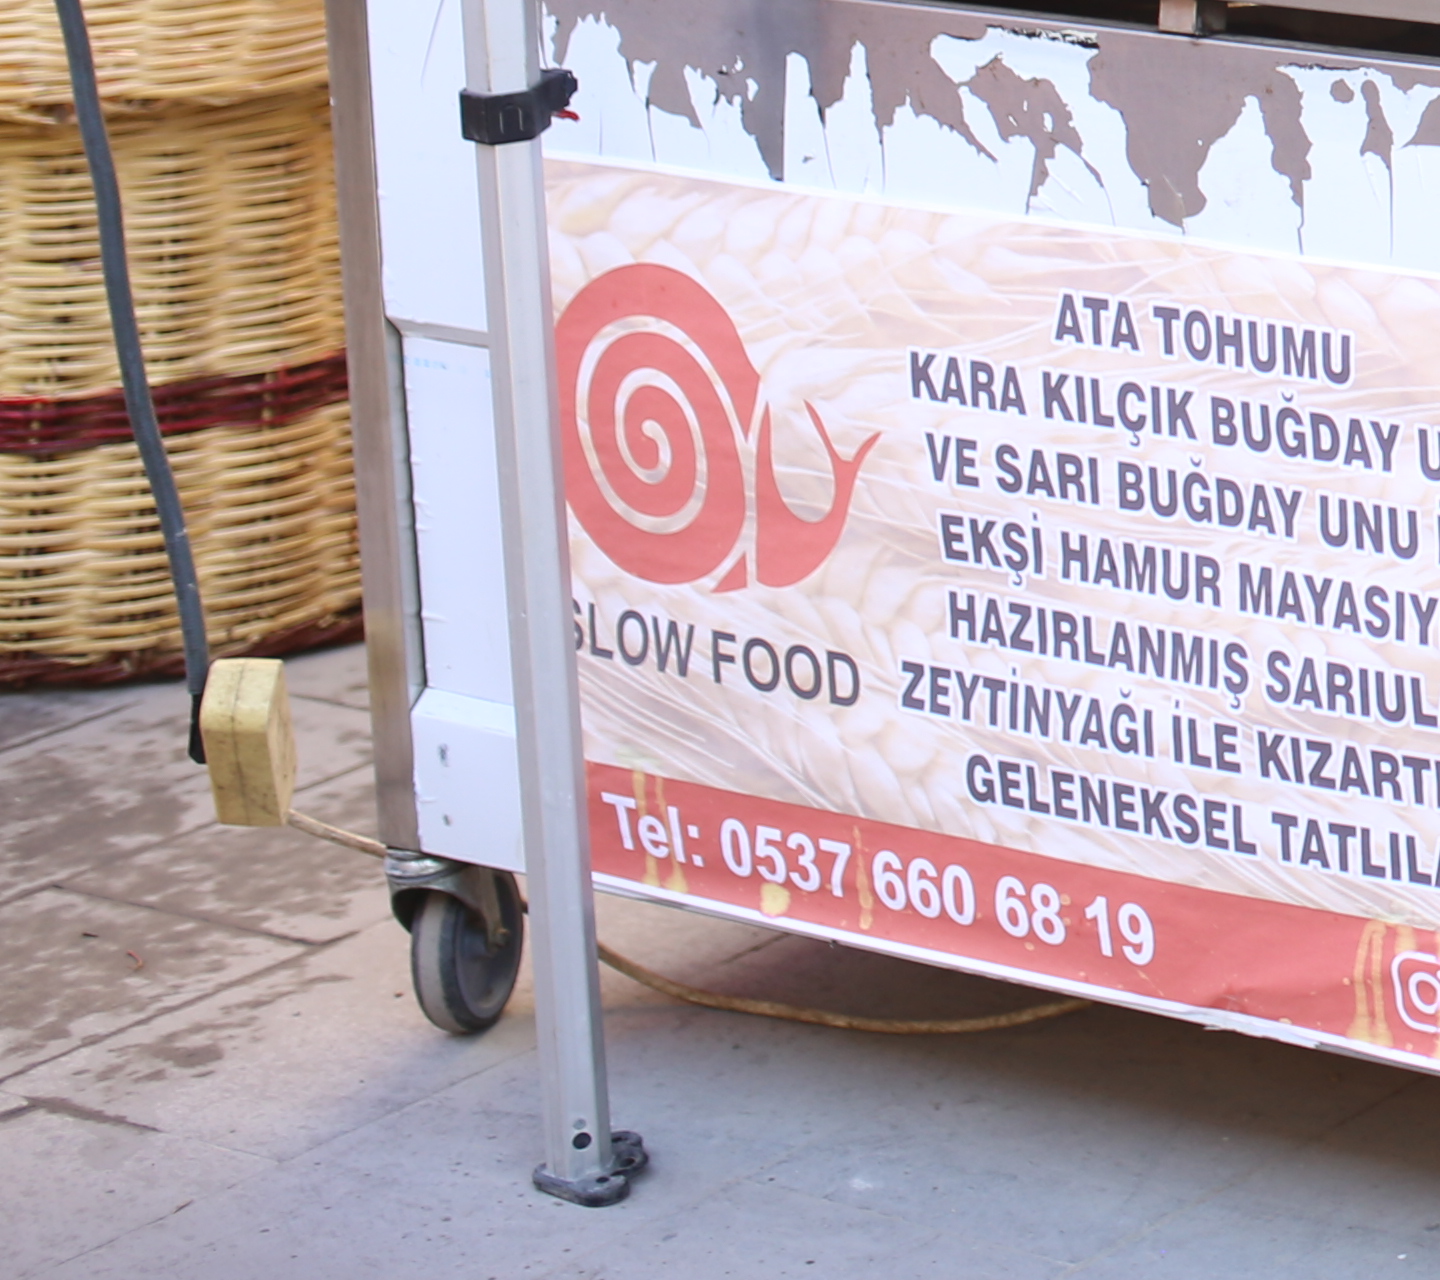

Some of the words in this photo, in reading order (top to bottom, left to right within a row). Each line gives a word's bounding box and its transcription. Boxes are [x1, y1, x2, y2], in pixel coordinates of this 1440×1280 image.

[1055, 293, 1139, 351] ATA
[1153, 306, 1351, 385] TOHUMU
[910, 351, 1027, 416] KARA
[1042, 370, 1198, 447] KILÇIK
[1210, 392, 1400, 472] BUĞDAY
[925, 432, 980, 487] VE
[996, 444, 1100, 505] SARI
[1117, 456, 1302, 539] BUĞDAY
[1319, 494, 1418, 560] UNU
[941, 512, 1043, 586] EKŞİ
[1061, 531, 1221, 607] HAMUR
[711, 629, 861, 707] FOOD
[949, 591, 1249, 710] HAZIRLANMIŞ
[902, 660, 1154, 758] ZEYTİNYAĞI
[1172, 699, 1241, 773] İLE
[967, 754, 1257, 855] GELENEKSEL
[602, 791, 705, 868] Tel:
[720, 817, 850, 897] 0537
[873, 849, 976, 926] 660
[995, 876, 1067, 946] 68
[1085, 896, 1155, 966] 19
